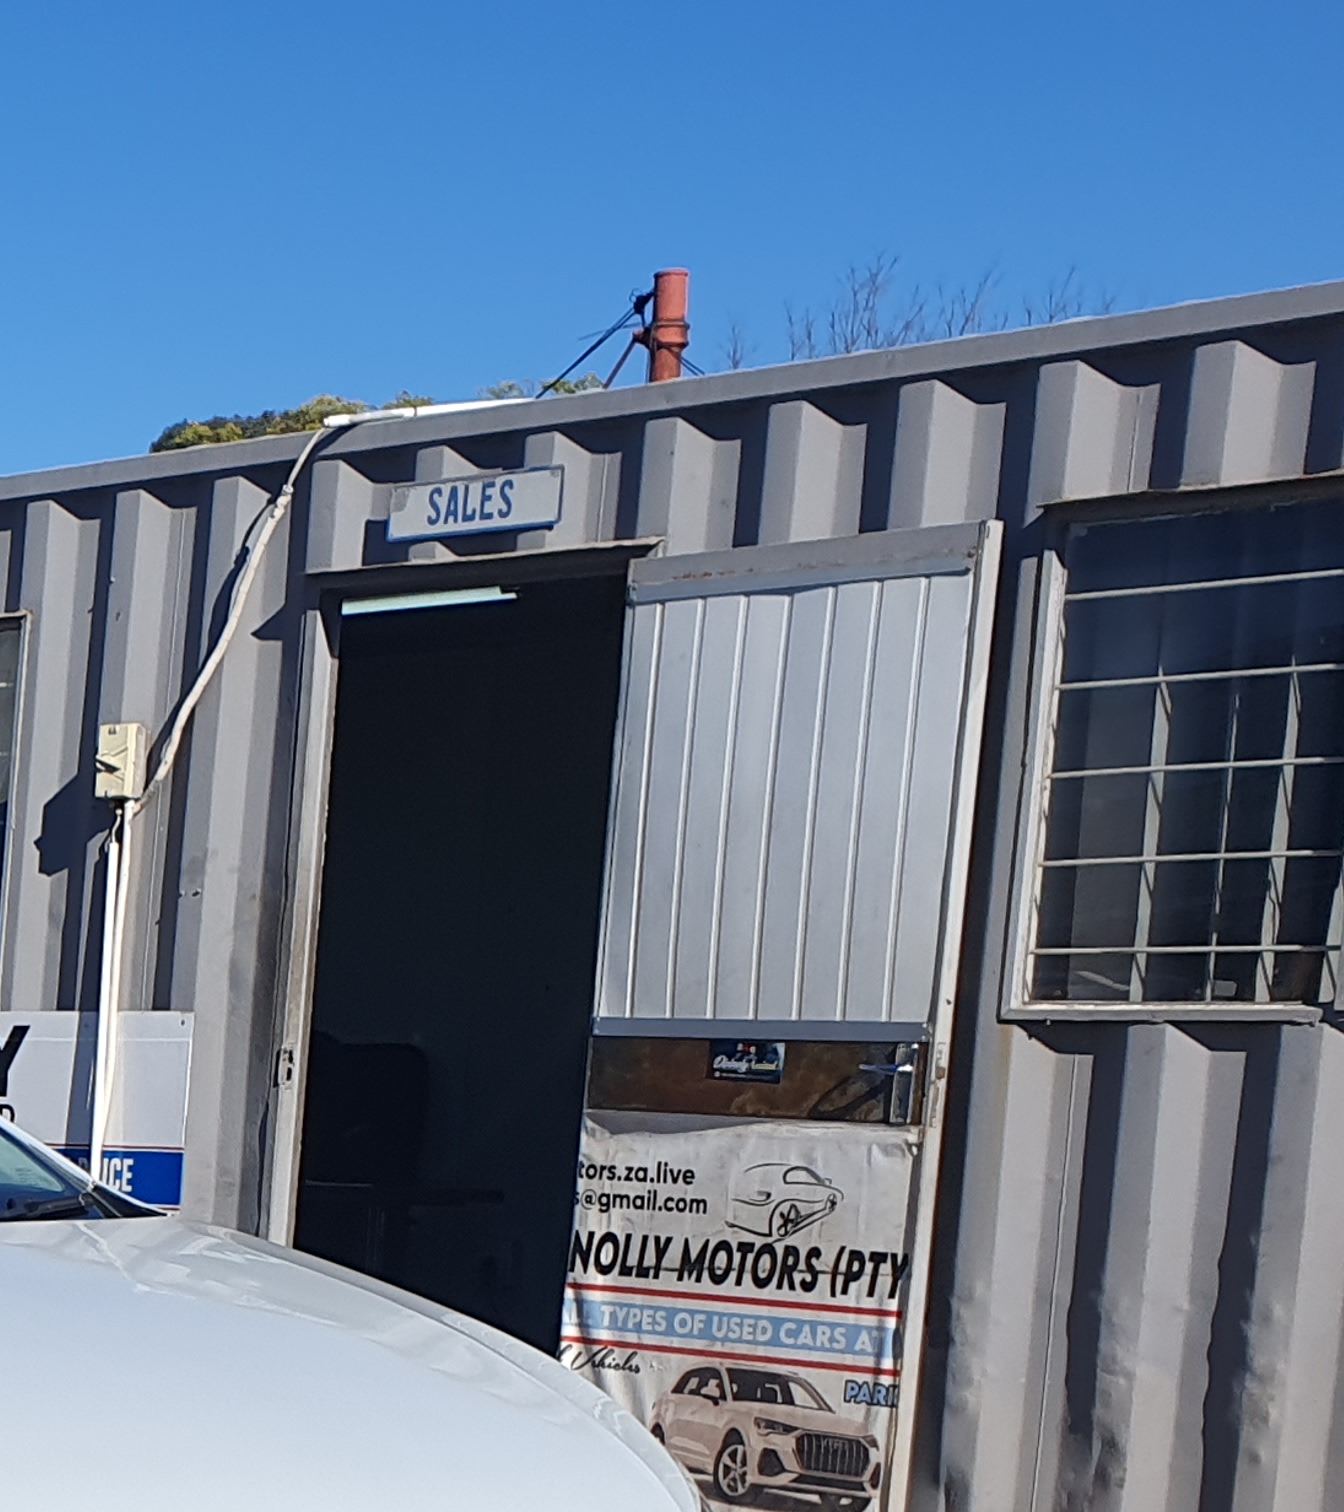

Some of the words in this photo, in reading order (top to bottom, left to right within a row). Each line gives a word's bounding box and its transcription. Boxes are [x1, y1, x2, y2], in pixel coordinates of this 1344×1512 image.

[426, 479, 515, 526] SALES
[568, 1229, 674, 1280] NOLLY
[676, 1236, 823, 1294] MOTORS
[830, 1246, 910, 1300] (PTY
[599, 1304, 667, 1332] TYPES
[673, 1311, 710, 1336] OF
[712, 1315, 773, 1342] USED
[779, 1321, 847, 1350] CARS
